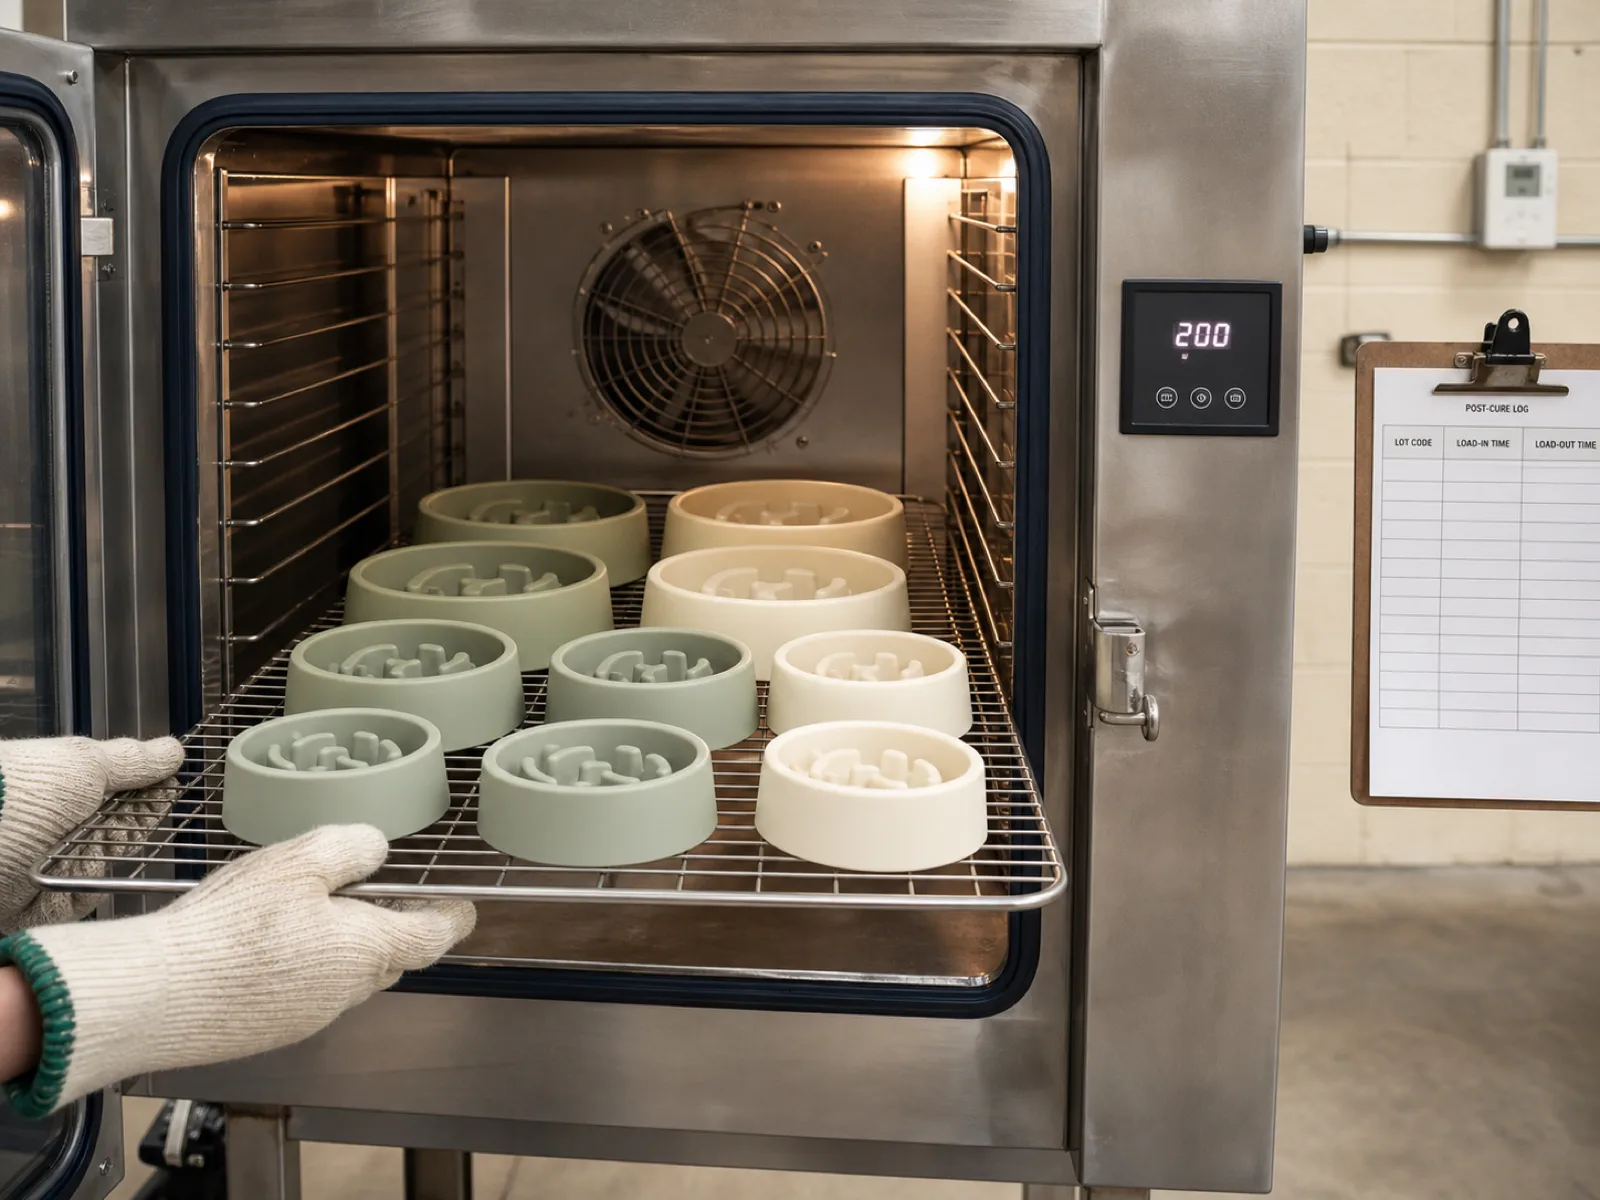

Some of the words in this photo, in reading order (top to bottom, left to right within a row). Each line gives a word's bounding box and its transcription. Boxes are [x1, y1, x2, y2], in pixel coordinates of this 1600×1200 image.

[1175, 322, 1230, 347] 200
[1465, 404, 1511, 413] POST-CURE
[1513, 404, 1529, 413] LOG
[1394, 438, 1409, 446] LOT
[1411, 438, 1433, 447] CODE
[1456, 439, 1489, 448] LOAD-IN
[1492, 439, 1510, 448] TIME
[1535, 440, 1576, 449] LOAD-OUT
[1577, 441, 1597, 450] TIME
